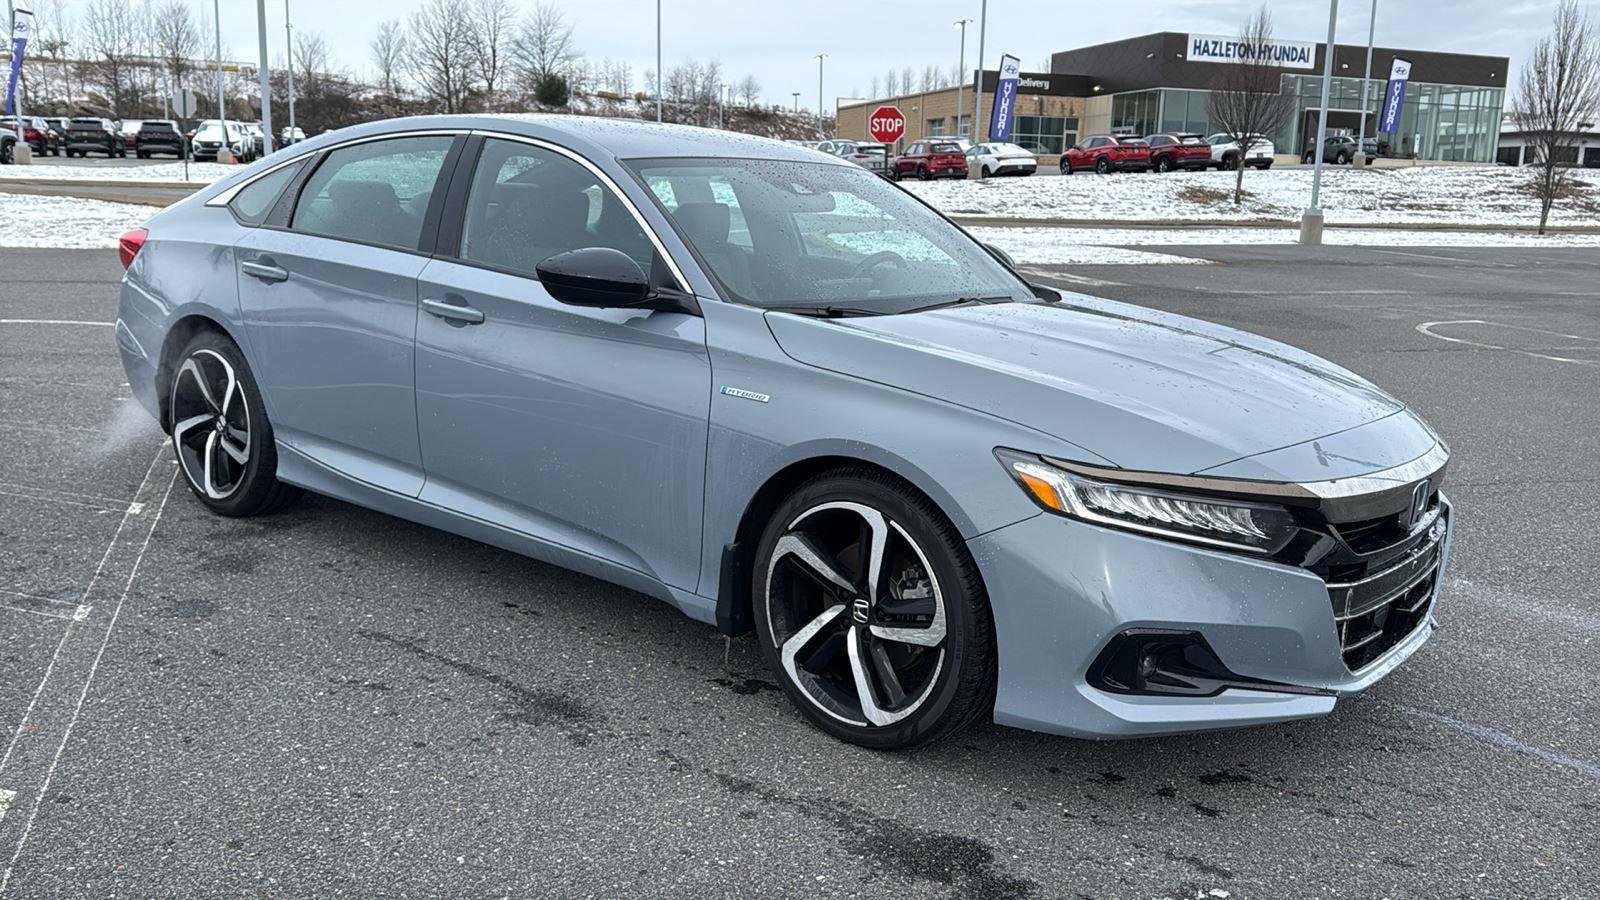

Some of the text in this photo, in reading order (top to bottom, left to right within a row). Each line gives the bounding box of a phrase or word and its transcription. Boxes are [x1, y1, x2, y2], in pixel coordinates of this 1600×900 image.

[1193, 38, 1311, 64] HAZLETON HYUNDAI
[1017, 77, 1050, 90] Delivery
[997, 81, 1013, 137] HYUNDAI
[1386, 81, 1402, 132] HYUNDAI
[872, 117, 903, 133] STOP
[727, 388, 767, 401] HYBRID
